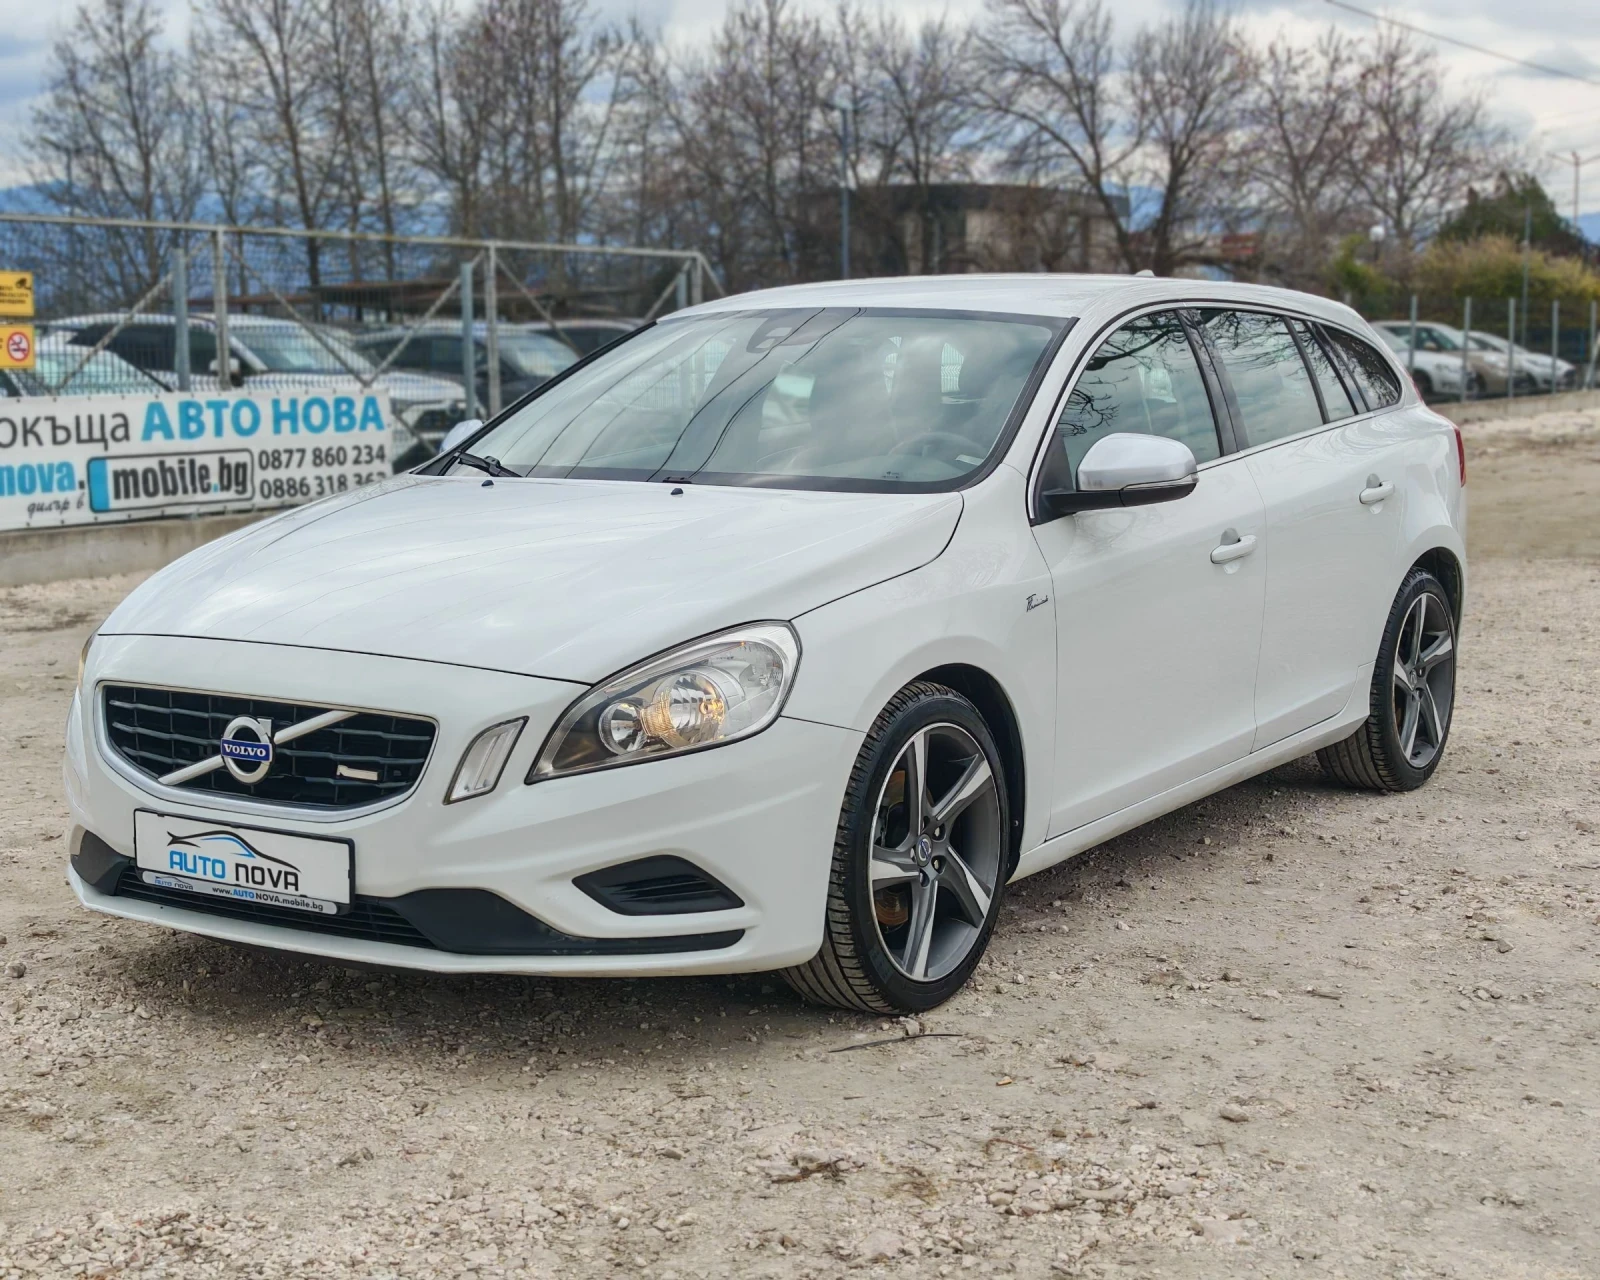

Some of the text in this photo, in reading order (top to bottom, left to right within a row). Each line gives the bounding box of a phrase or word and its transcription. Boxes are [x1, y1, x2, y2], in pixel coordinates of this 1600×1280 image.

[141, 398, 261, 442] АВТО
[271, 396, 385, 435] НОВА
[258, 444, 386, 471] 0877 860 234
[112, 456, 248, 500] mobile.bg
[260, 477, 311, 499] 0886
[314, 474, 348, 496] 318
[223, 743, 266, 757] VOLVO
[169, 850, 299, 892] AUTO NOVA
